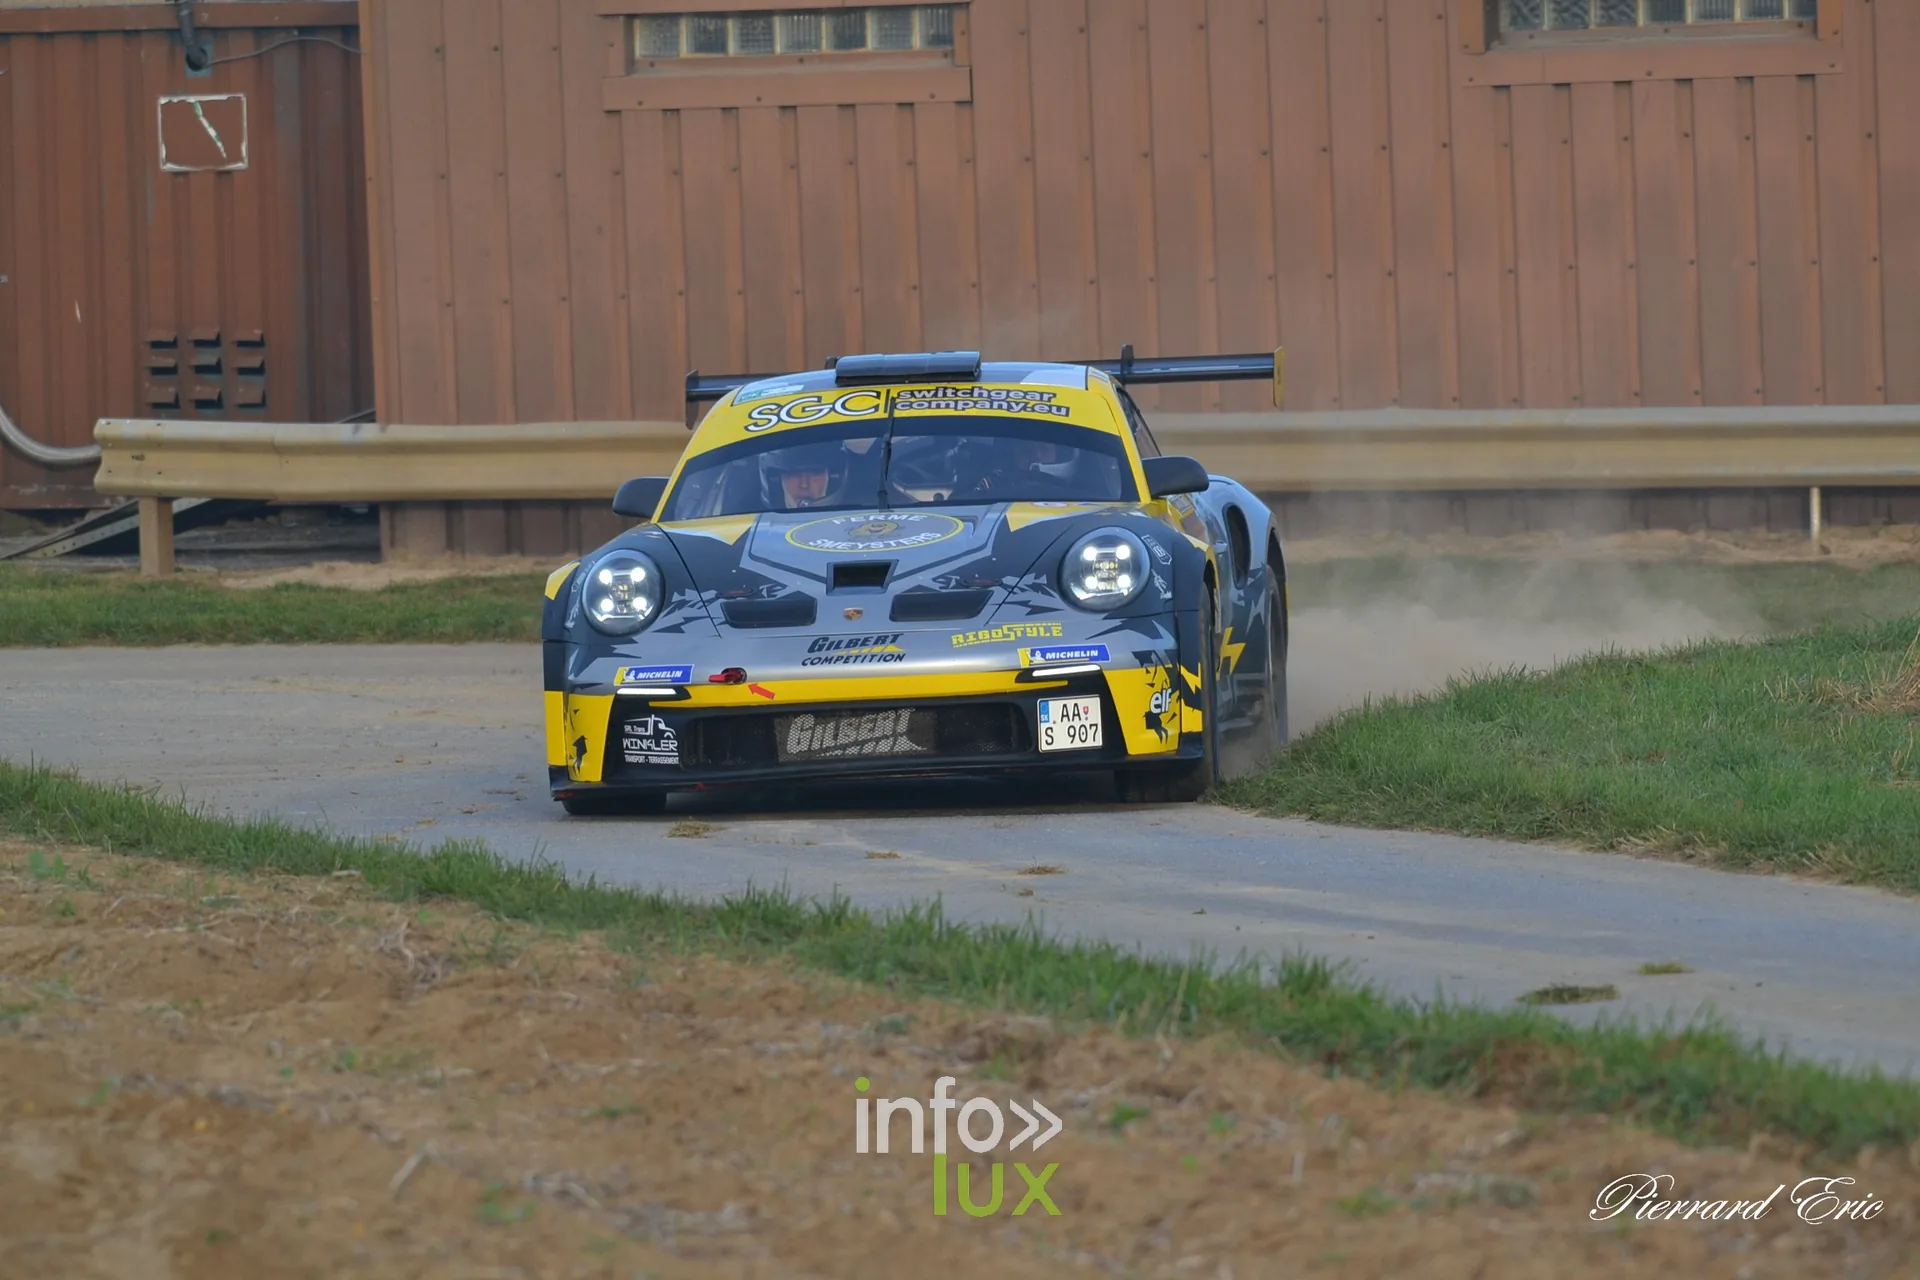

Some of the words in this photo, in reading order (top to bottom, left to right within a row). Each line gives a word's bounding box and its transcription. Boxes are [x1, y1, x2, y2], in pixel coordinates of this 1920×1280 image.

[897, 386, 1056, 402] switchgear
[744, 390, 881, 432] SGC
[894, 399, 1069, 417] company.eu
[832, 514, 928, 525] FERME
[809, 532, 942, 550] SMEYSTERS
[807, 633, 904, 654] GILBERT
[801, 653, 906, 666] COMPETITION
[1045, 650, 1099, 660] MICHELIN
[636, 670, 683, 679] MICHELIN
[1150, 687, 1171, 714] elf
[1060, 703, 1081, 722] AA
[1044, 727, 1054, 745] S
[1067, 724, 1098, 744] 907
[622, 738, 678, 751] WINKLER
